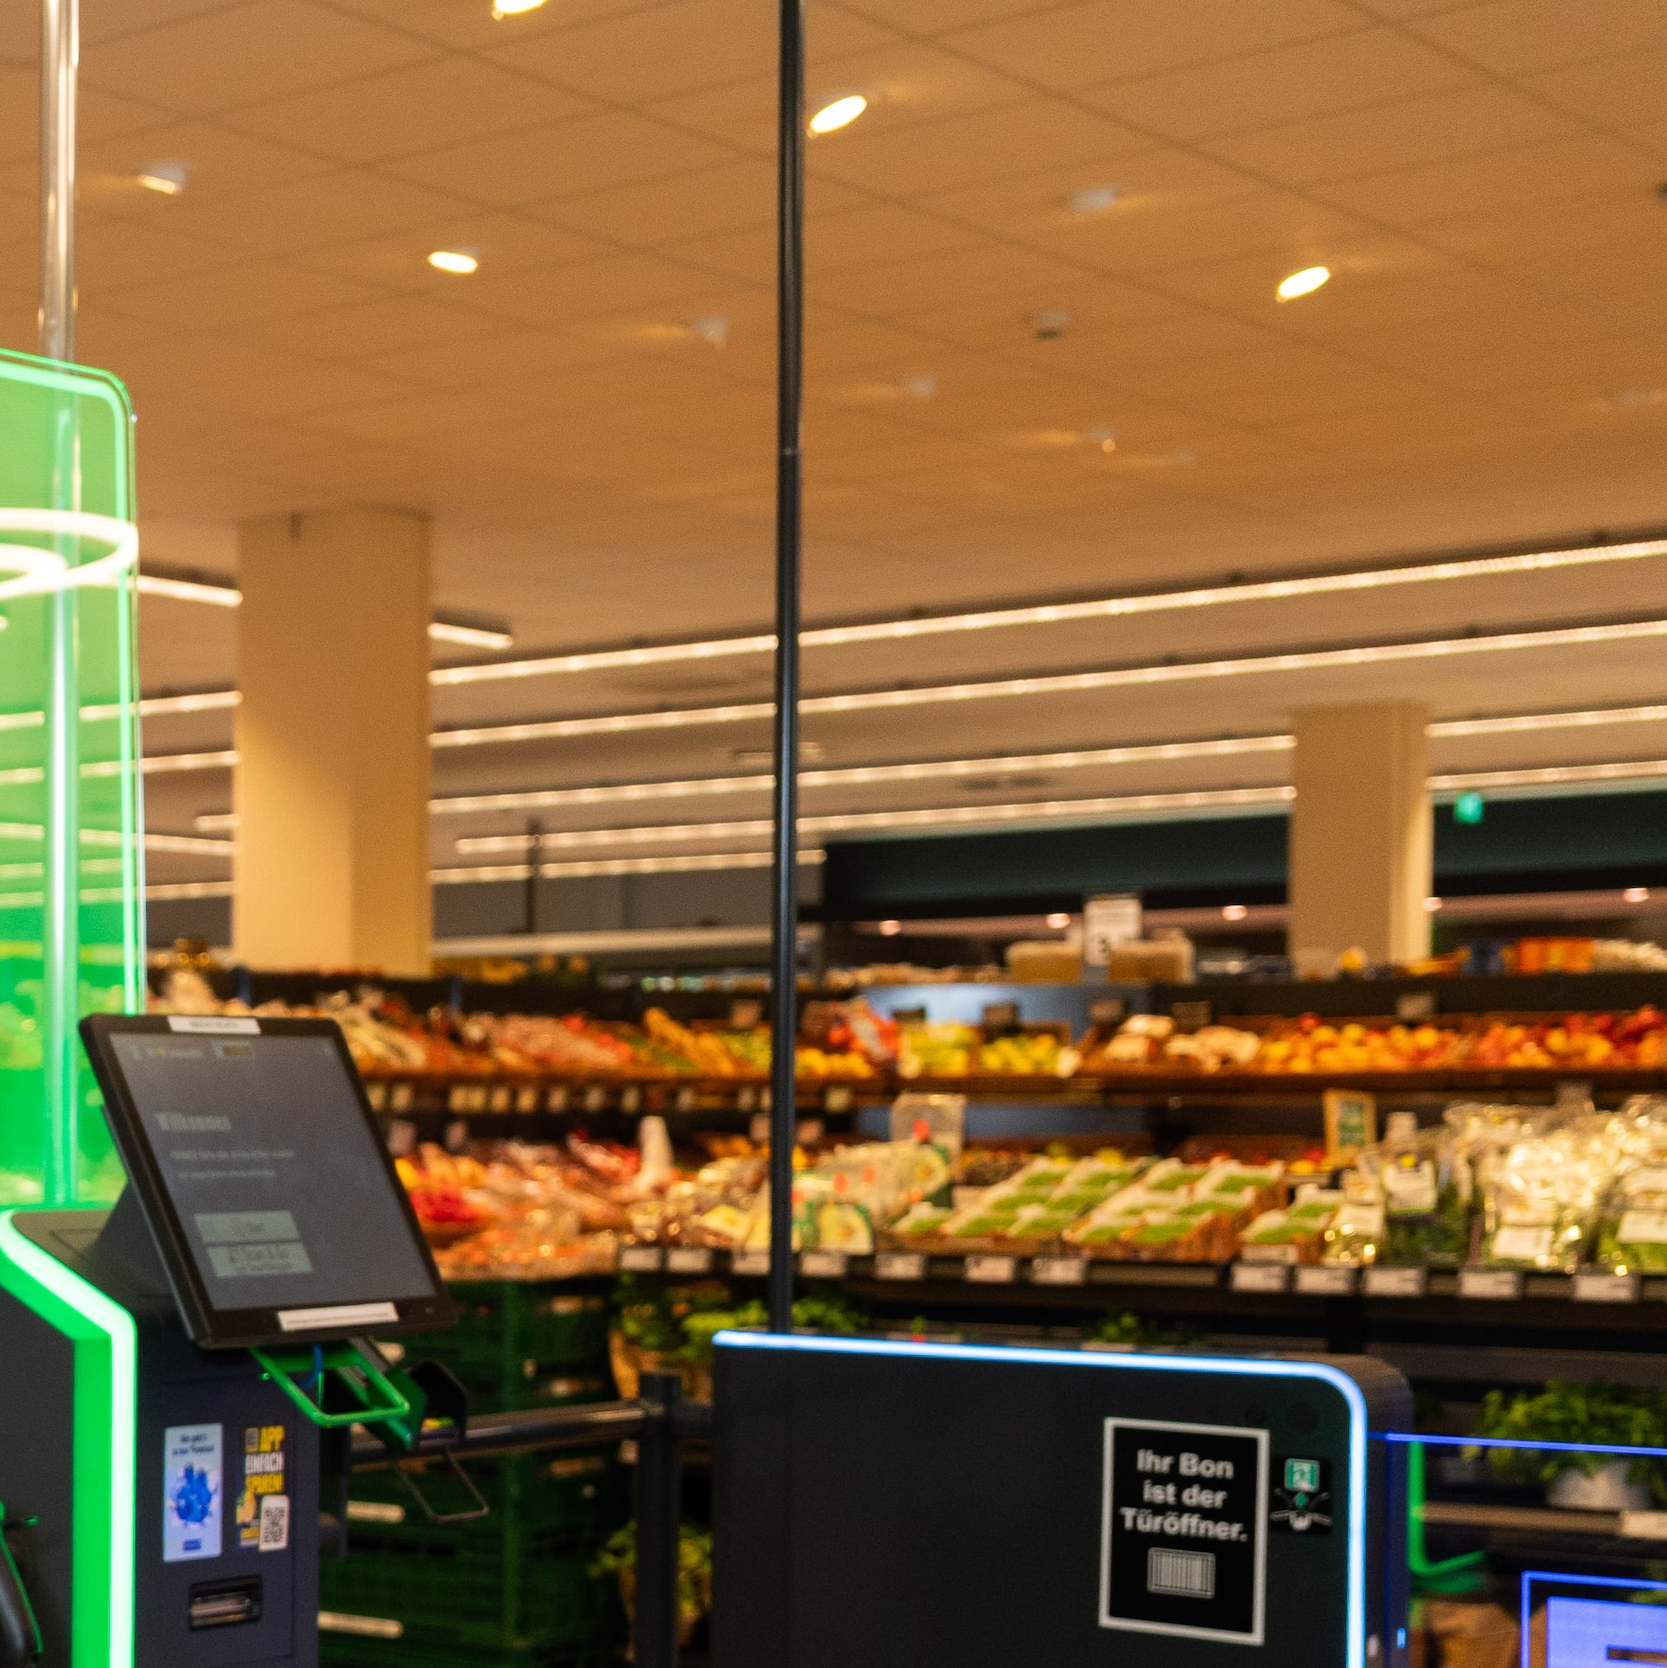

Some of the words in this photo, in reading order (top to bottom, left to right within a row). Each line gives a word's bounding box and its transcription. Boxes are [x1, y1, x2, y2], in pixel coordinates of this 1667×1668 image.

[1136, 1449, 1175, 1474] Ihr
[1179, 1452, 1235, 1480] Bon
[1142, 1479, 1177, 1505] ist
[1181, 1484, 1228, 1509] der
[1119, 1507, 1249, 1543] Türöffner.
